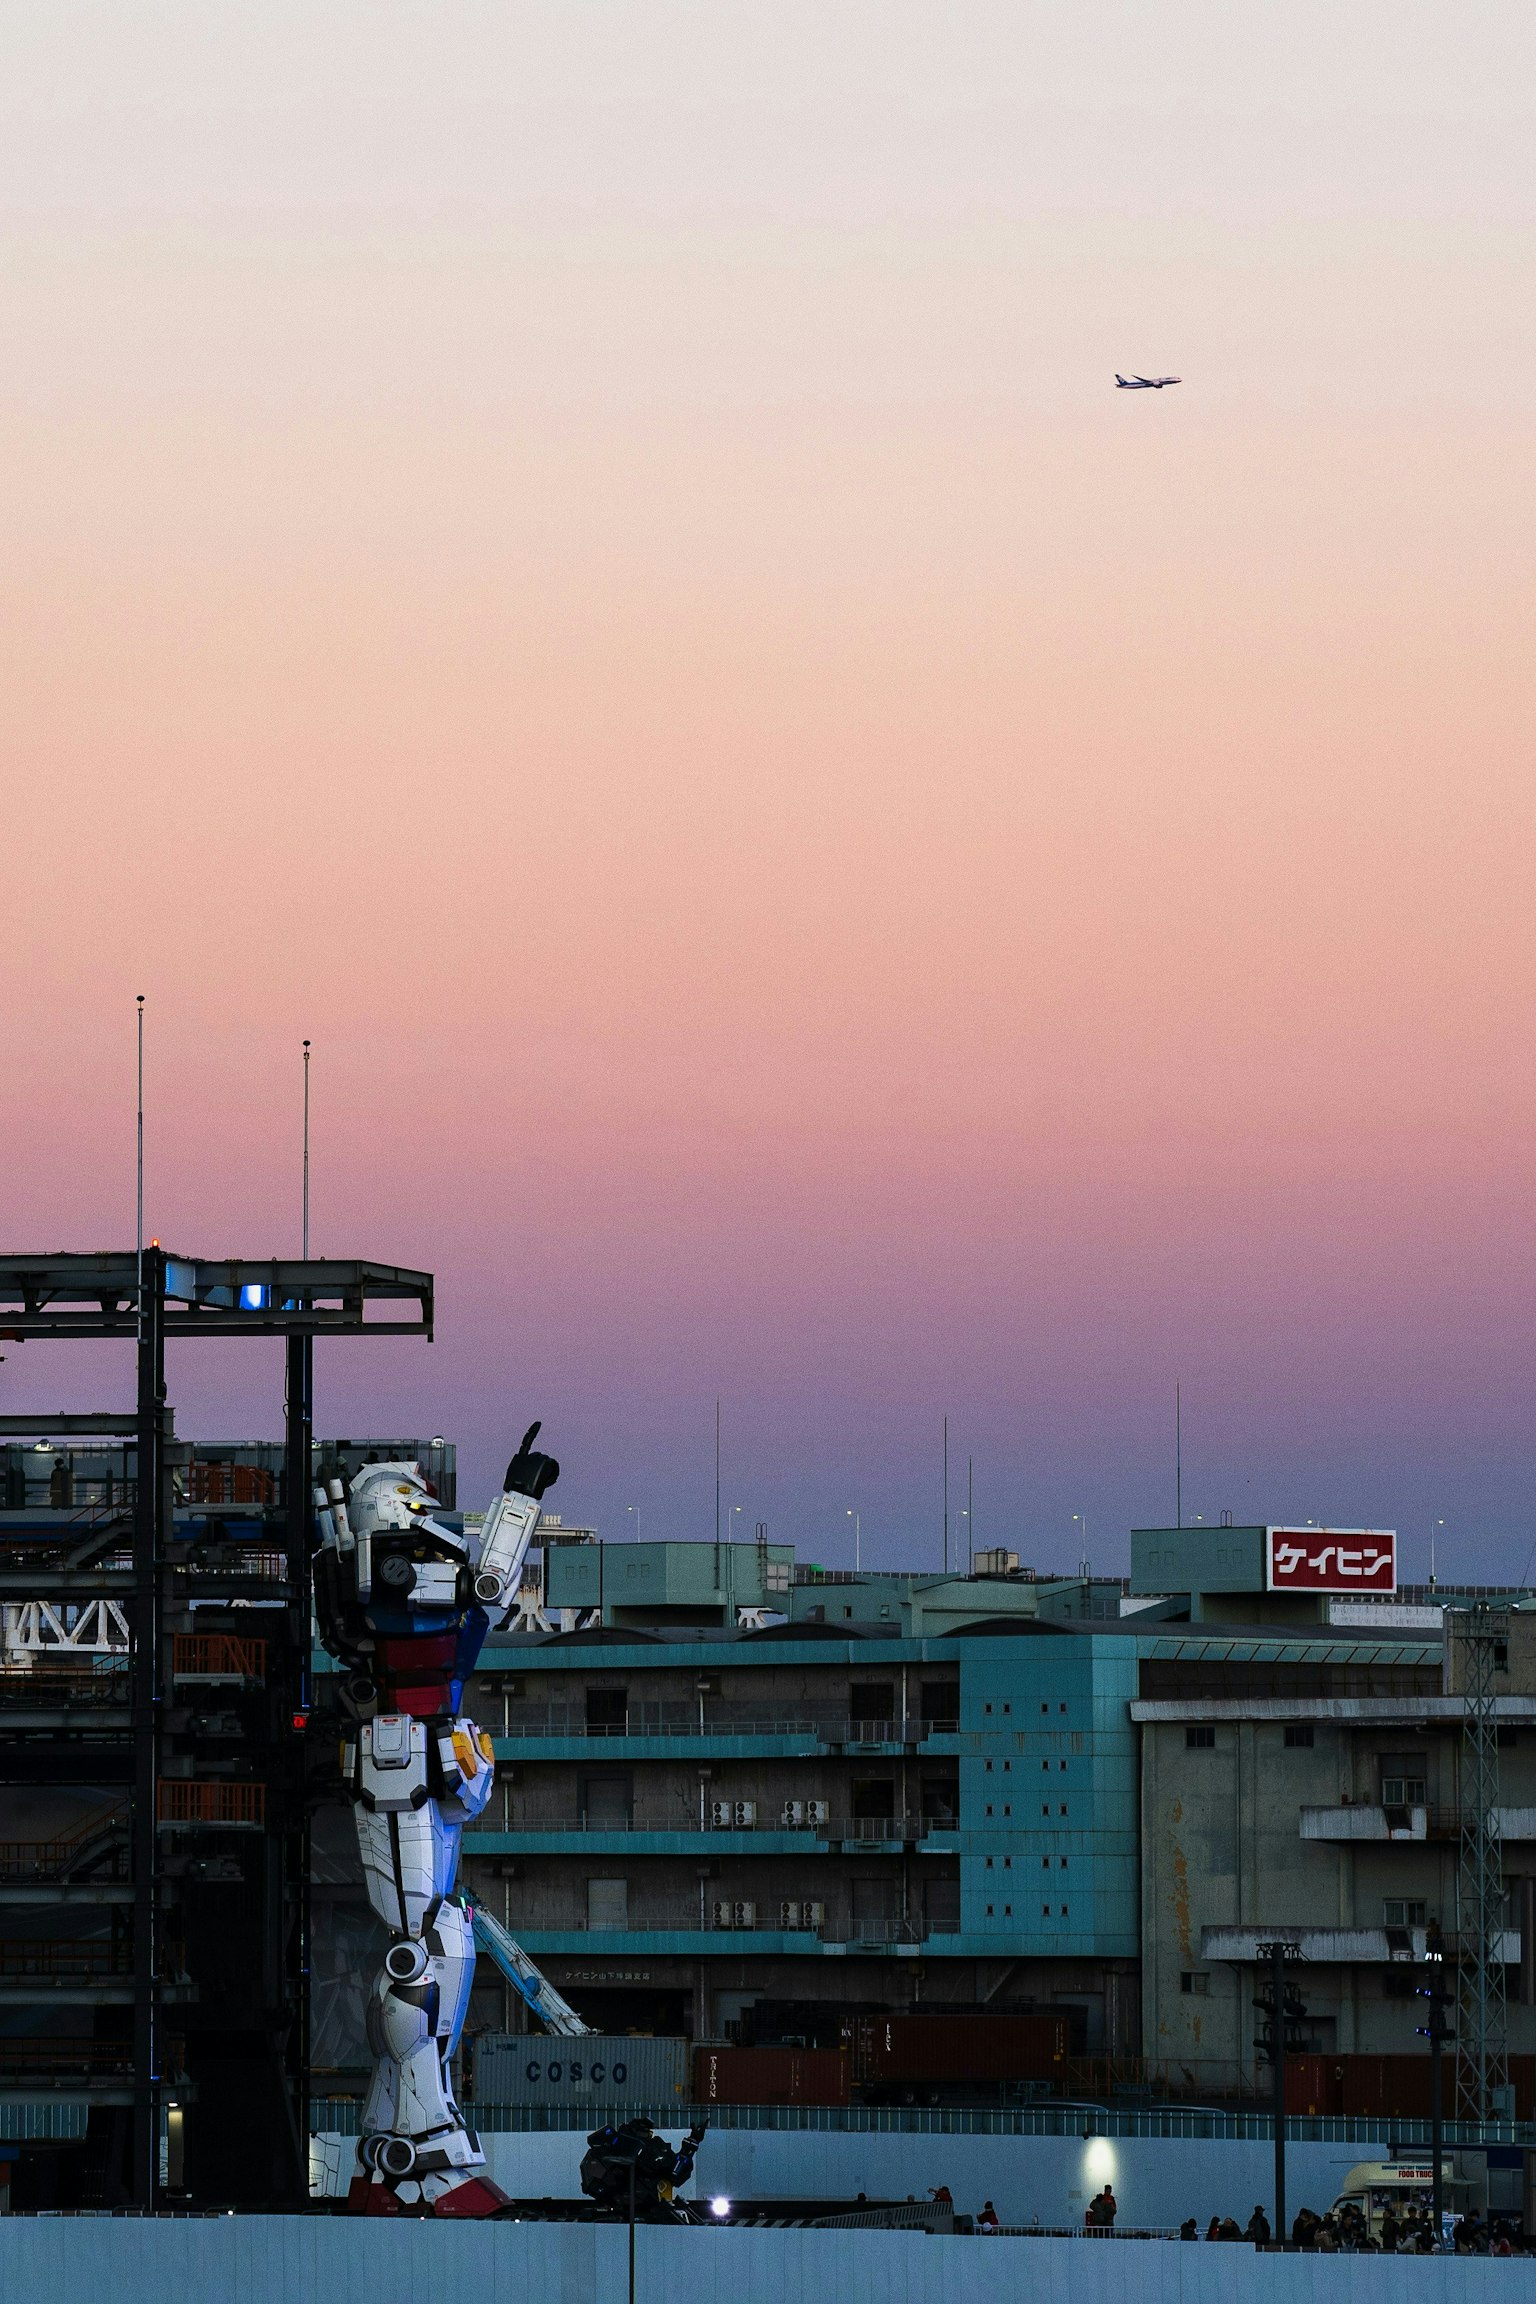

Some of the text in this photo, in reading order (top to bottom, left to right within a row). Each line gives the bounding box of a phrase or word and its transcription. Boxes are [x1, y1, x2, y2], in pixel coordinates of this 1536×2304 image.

[1274, 1543, 1392, 1576] ケイヒン
[526, 2061, 628, 2084] COSCO
[709, 2056, 718, 2098] TRITON
